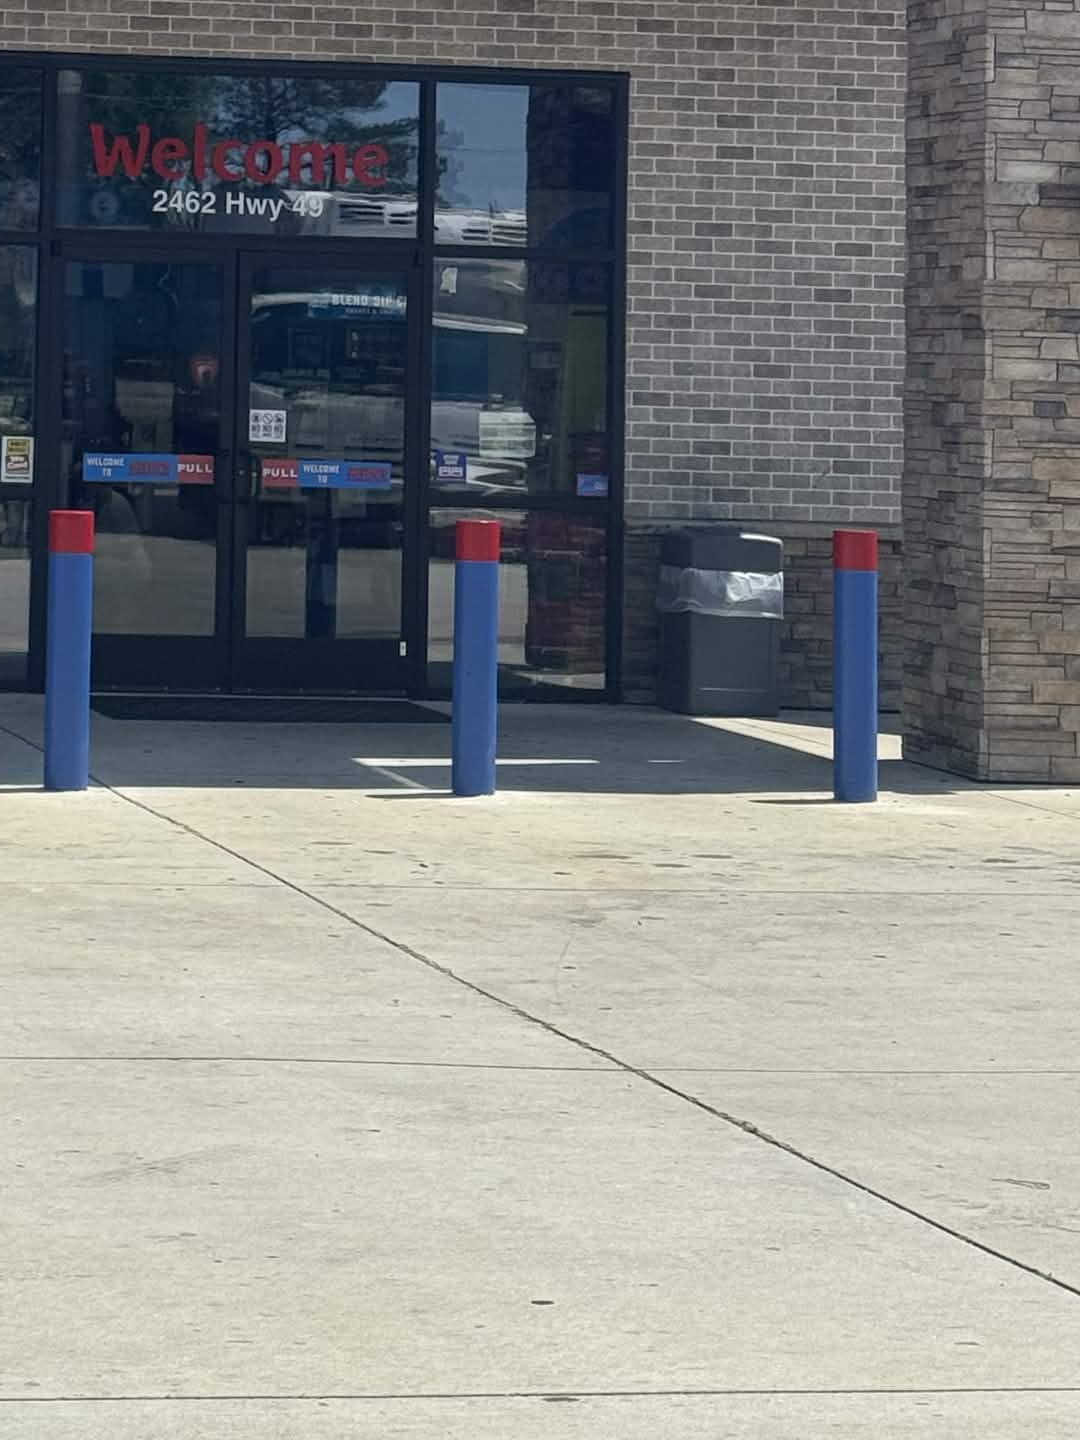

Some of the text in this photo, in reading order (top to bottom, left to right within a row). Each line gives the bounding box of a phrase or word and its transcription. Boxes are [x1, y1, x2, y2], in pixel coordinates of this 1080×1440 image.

[90, 122, 389, 186] Welcome
[152, 189, 325, 222] 2462 Hwy 49
[177, 463, 213, 473] PULL
[262, 467, 299, 478] PULL
[303, 464, 340, 474] WELCOME
